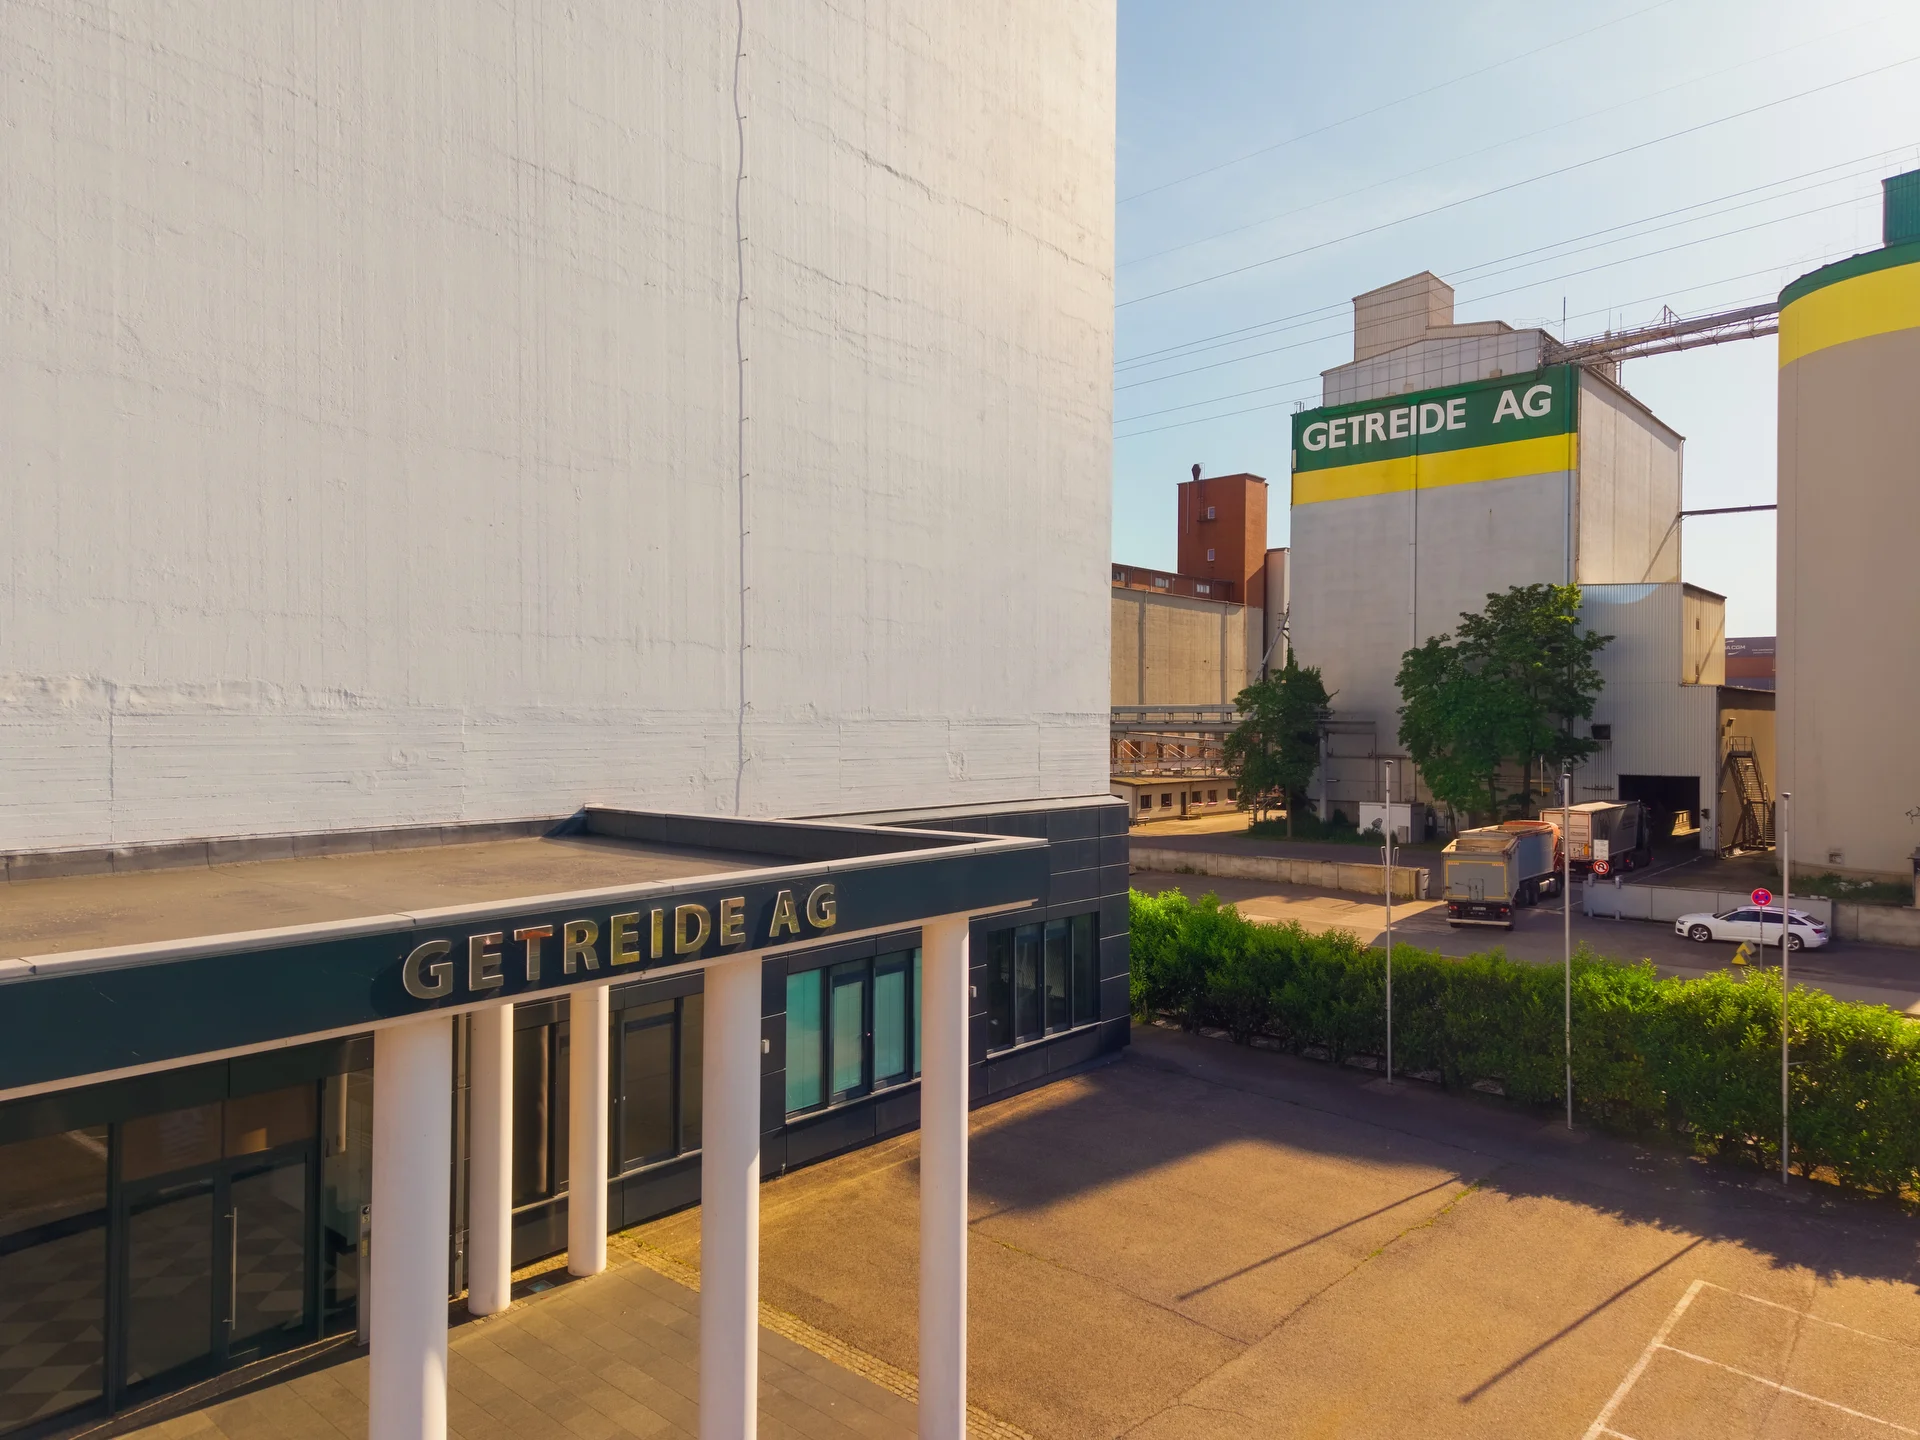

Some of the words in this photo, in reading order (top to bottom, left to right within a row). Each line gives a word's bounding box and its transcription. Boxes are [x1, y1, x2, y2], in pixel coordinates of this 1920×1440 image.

[1302, 397, 1467, 451] GETREIDE
[1492, 384, 1552, 424] AG
[402, 896, 746, 999] GETREIDE
[768, 883, 837, 938] AG
